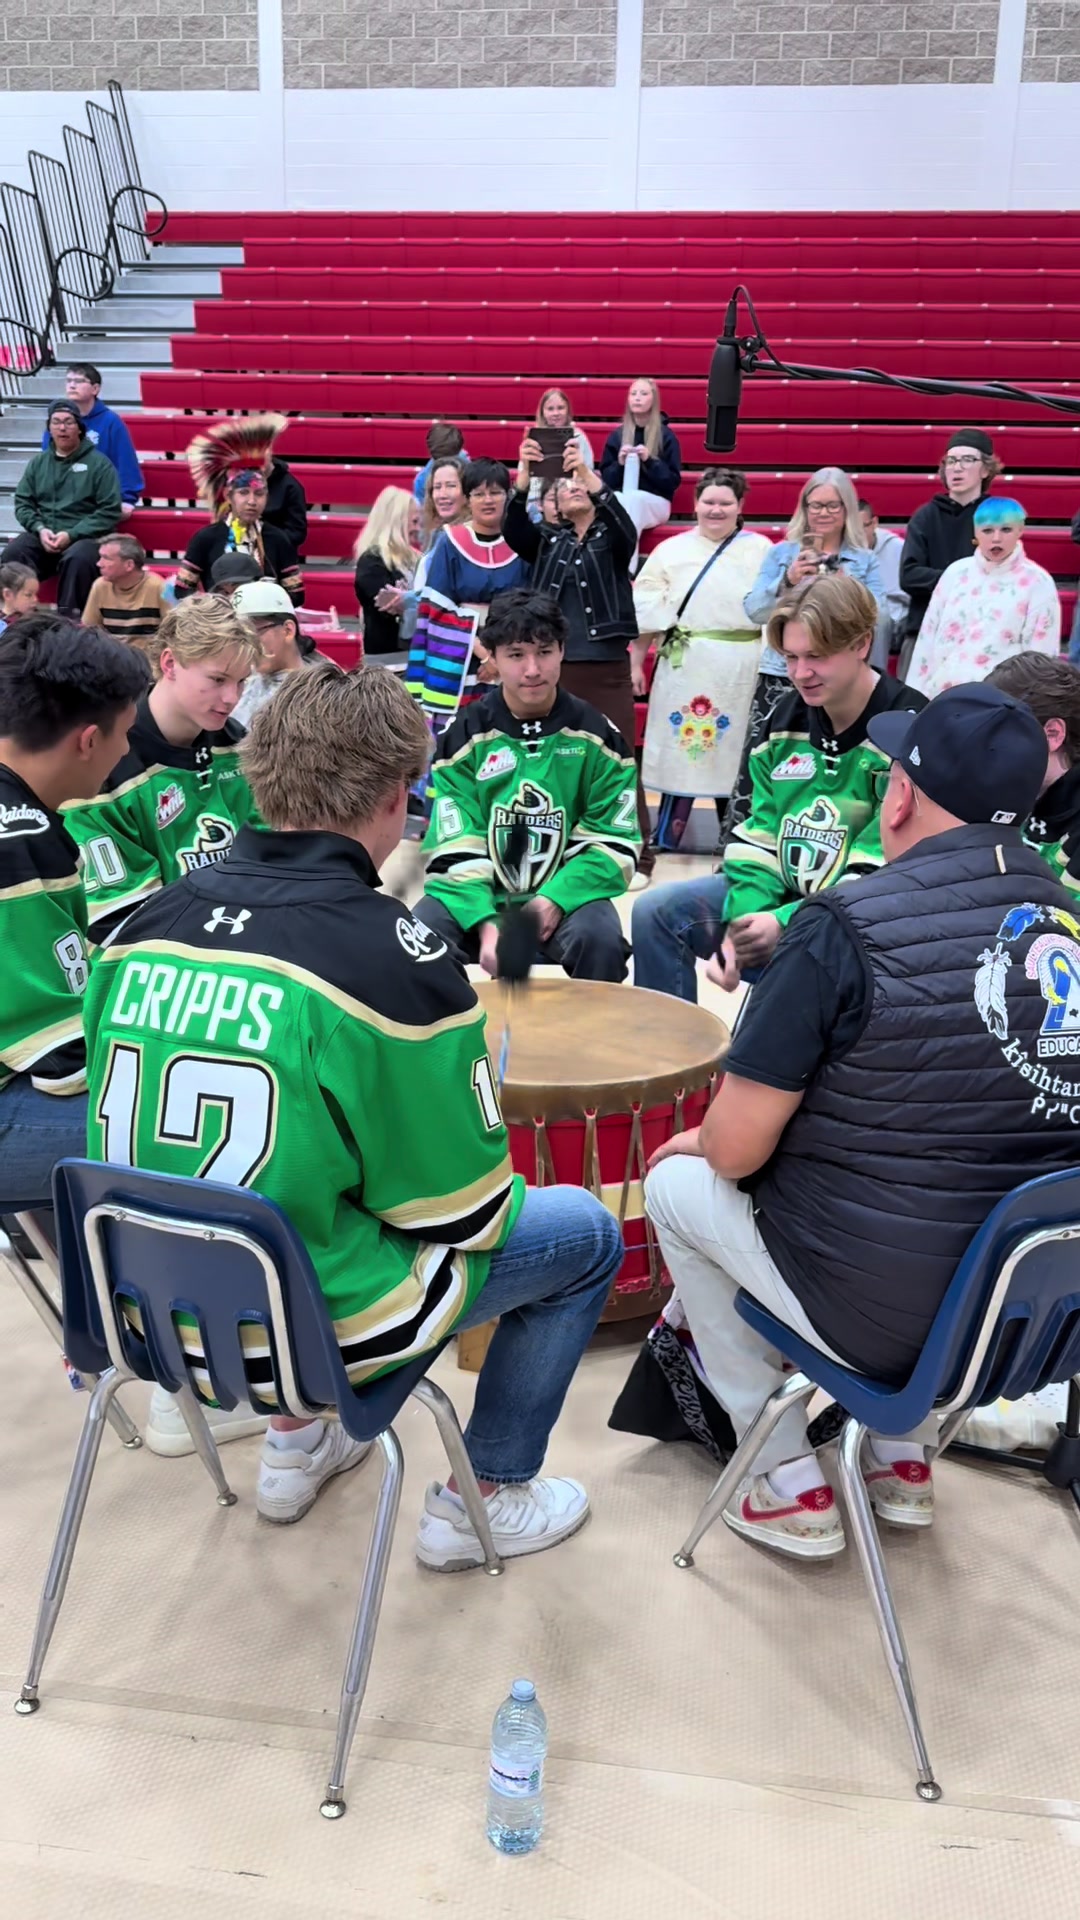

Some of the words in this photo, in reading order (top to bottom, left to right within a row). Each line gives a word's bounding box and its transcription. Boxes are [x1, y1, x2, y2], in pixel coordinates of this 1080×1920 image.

[437, 796, 464, 842] 5
[496, 808, 562, 830] RADERS
[611, 789, 637, 830] 2
[784, 820, 845, 850] RAIDERS
[110, 960, 284, 1052] CRIPPS
[471, 1054, 502, 1131] 1
